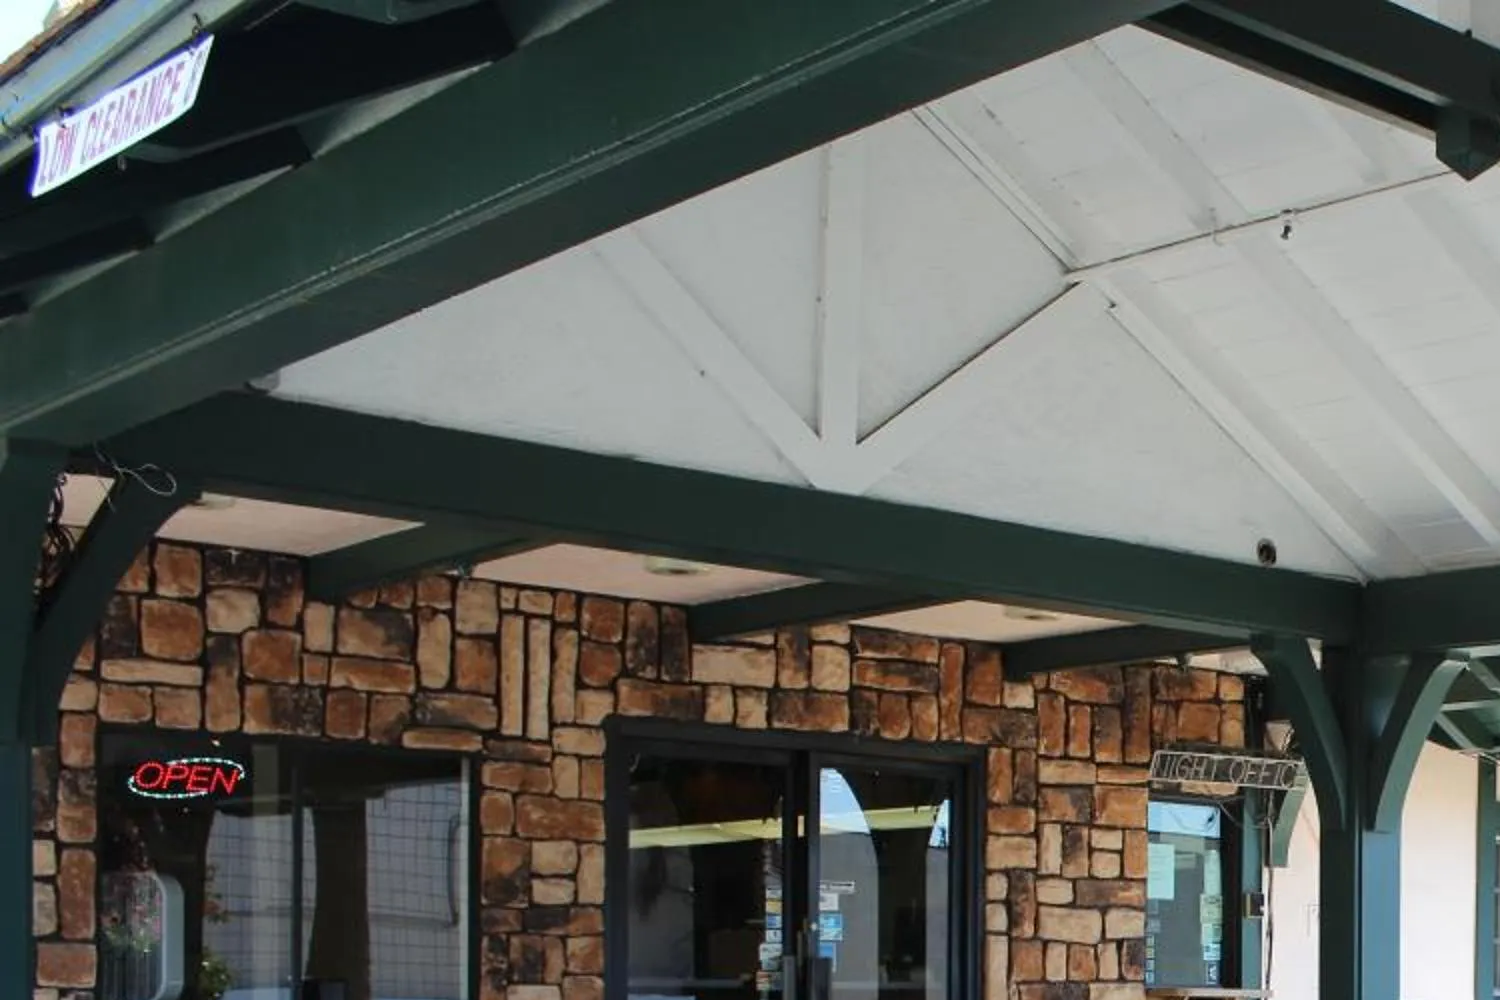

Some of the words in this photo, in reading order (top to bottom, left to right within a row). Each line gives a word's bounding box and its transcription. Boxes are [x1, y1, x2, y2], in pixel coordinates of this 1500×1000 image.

[80, 60, 186, 166] CLEARANCE
[135, 761, 238, 796] OPEN
[1151, 753, 1222, 782] NIGHT
